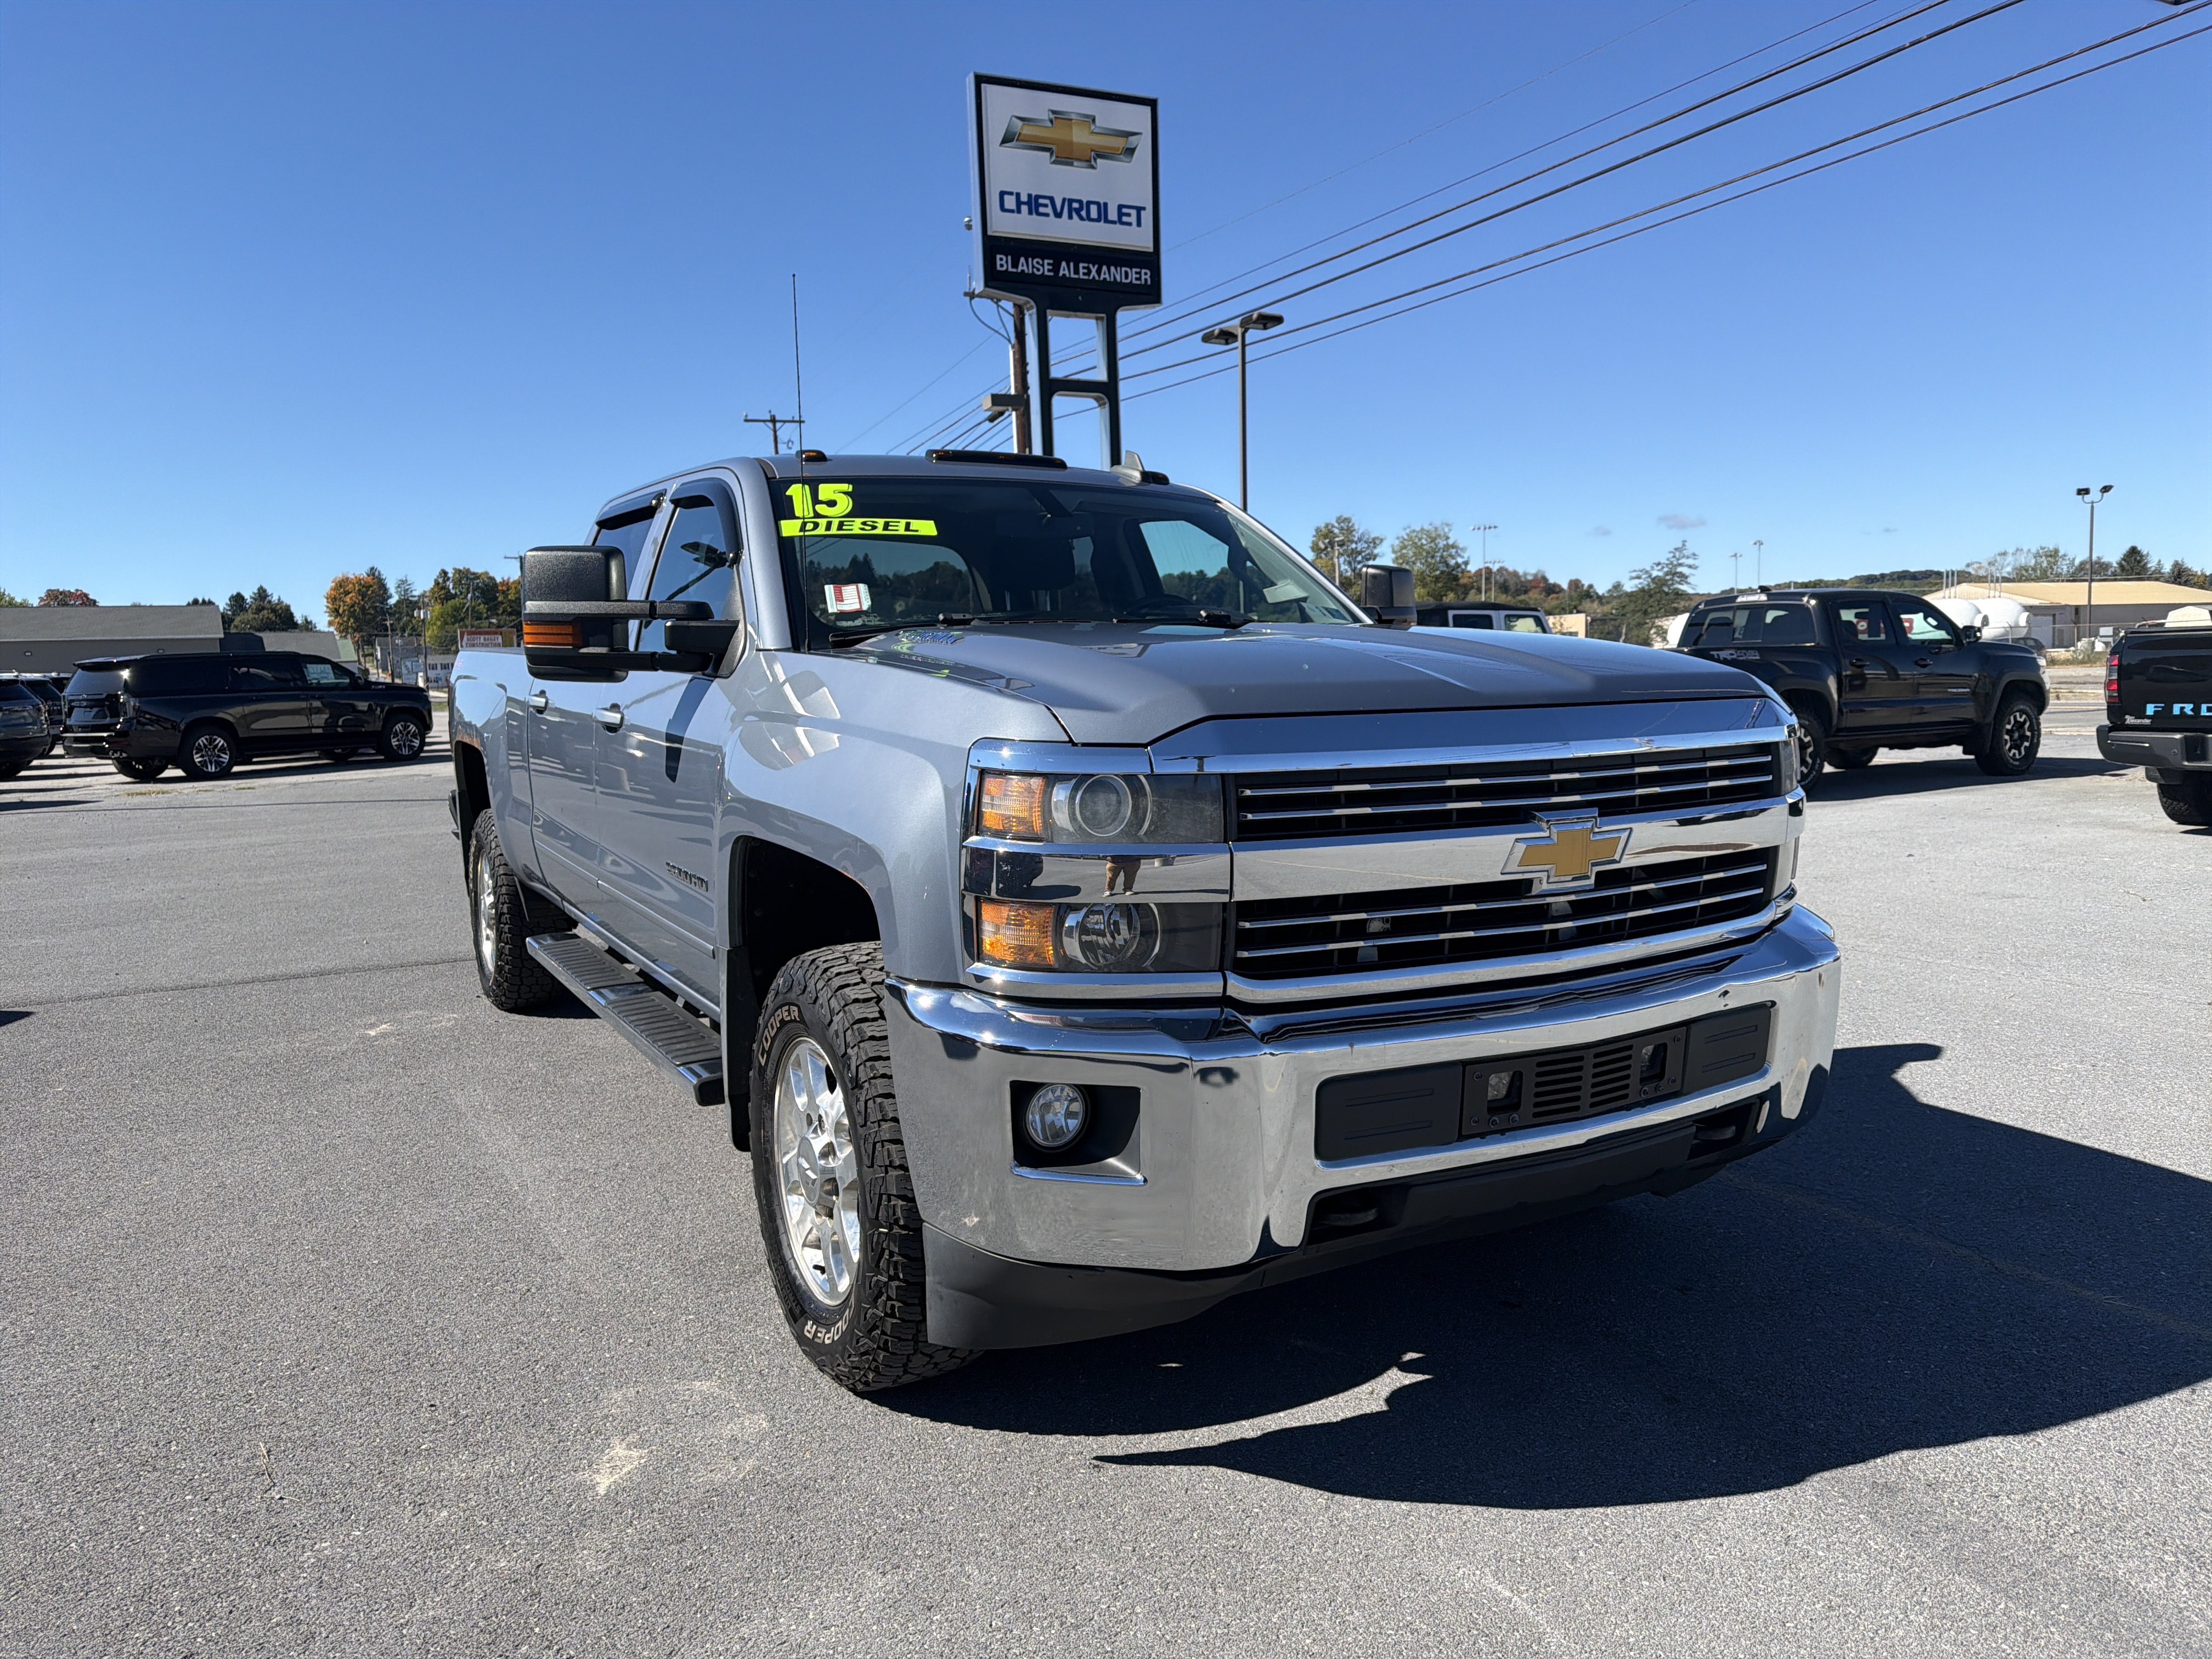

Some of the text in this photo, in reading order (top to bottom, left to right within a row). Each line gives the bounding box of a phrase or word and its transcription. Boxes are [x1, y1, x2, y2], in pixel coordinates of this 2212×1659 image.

[999, 190, 1147, 228] CHEVROLET
[996, 254, 1151, 285] BLAISE ALEXANDER
[786, 483, 853, 518] 15
[799, 520, 922, 533] DIESEL
[758, 1005, 800, 1066] COOPER
[804, 1293, 854, 1345] COOPER
